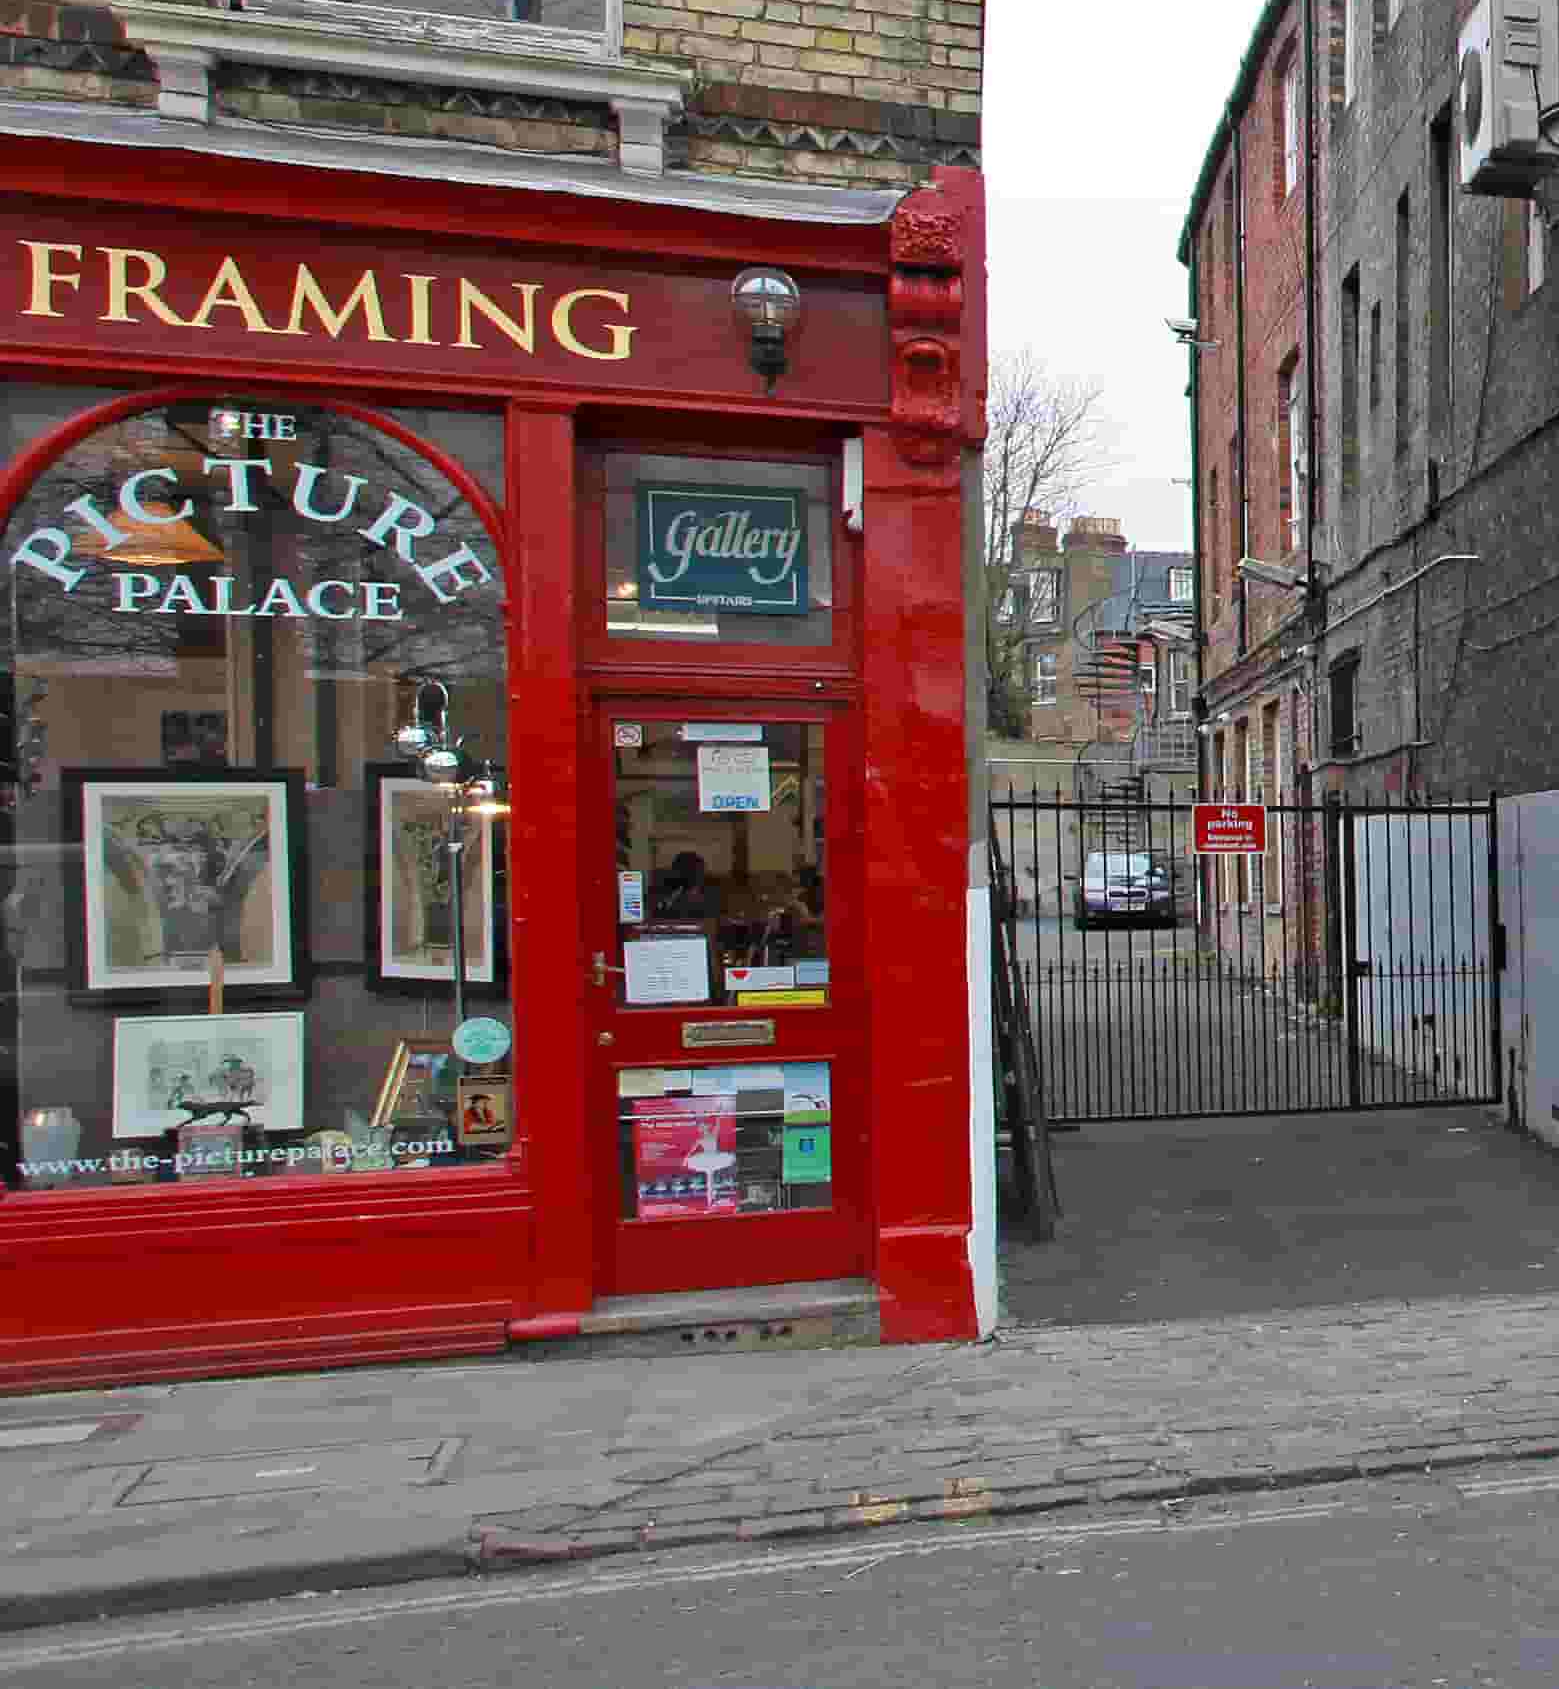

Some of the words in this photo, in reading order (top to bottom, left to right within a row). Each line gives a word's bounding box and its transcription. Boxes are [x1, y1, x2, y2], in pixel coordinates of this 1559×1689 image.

[16, 239, 640, 360] FRAMING
[209, 408, 298, 441] THE
[10, 455, 492, 606] PICTURE
[647, 510, 802, 584] Gallery
[112, 571, 403, 621] PALACE
[711, 794, 760, 809] OPEN
[15, 1137, 456, 1177] www.the-picturepalace.com
